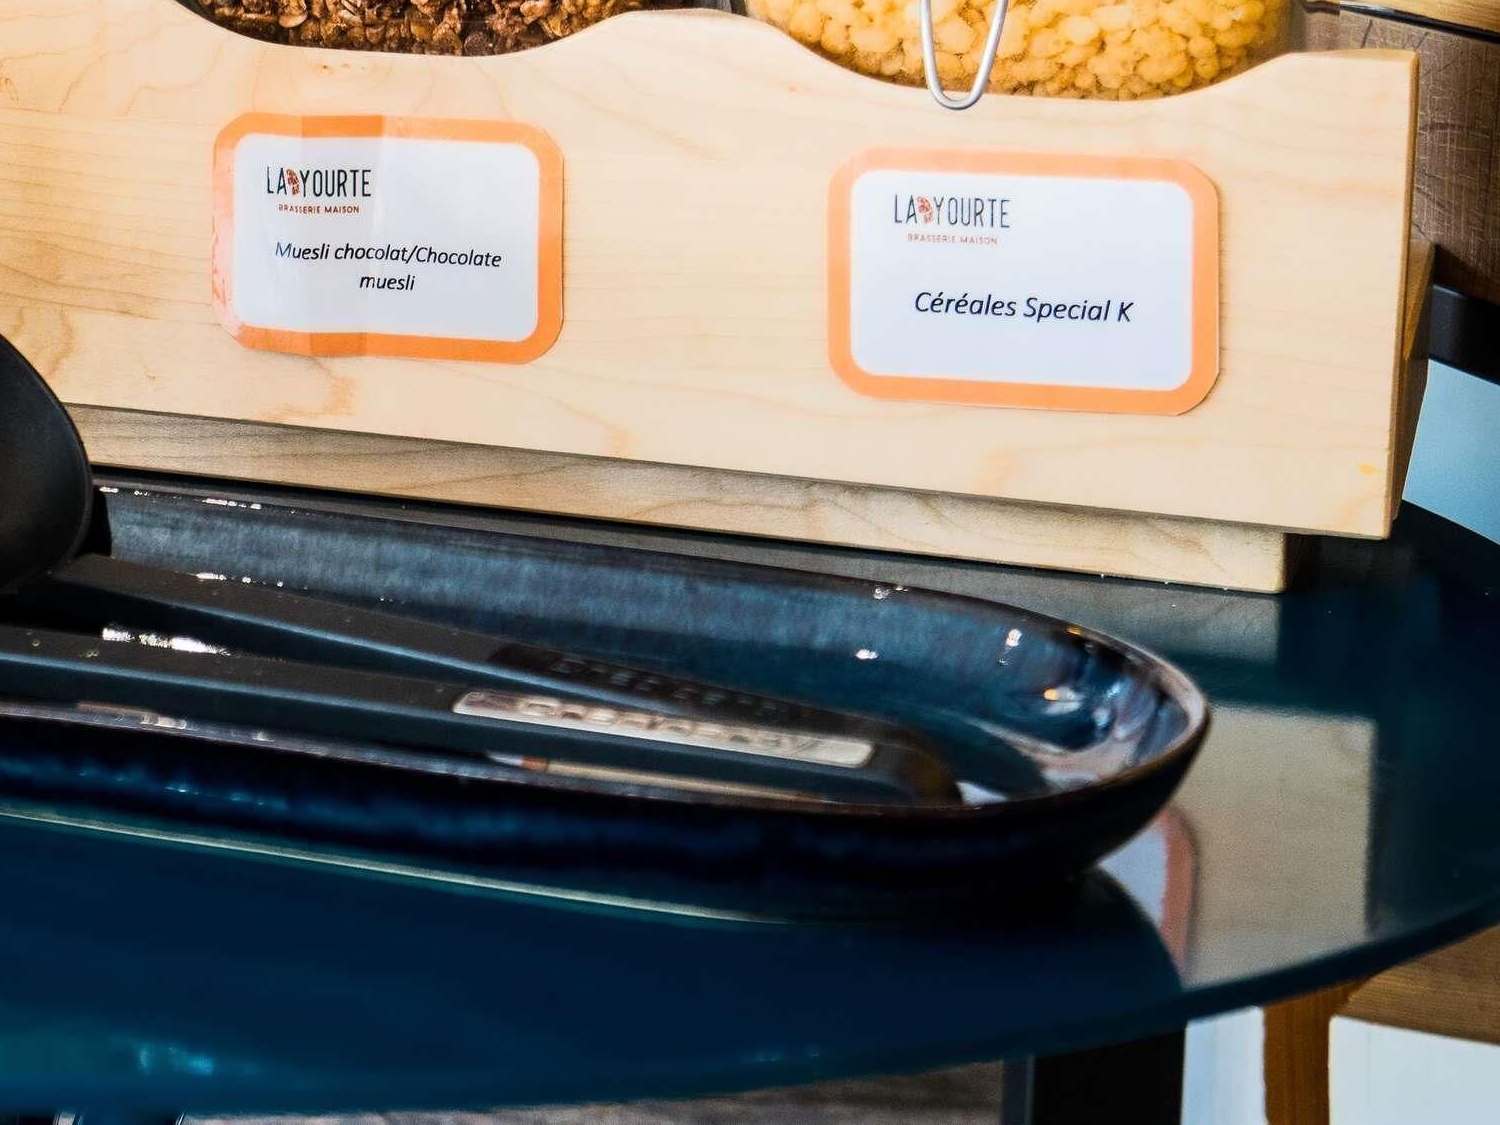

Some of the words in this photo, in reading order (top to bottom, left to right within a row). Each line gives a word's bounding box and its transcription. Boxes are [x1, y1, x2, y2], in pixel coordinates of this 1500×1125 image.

[266, 165, 287, 195] LA
[299, 169, 372, 198] YOURTE
[278, 203, 321, 215] BRASSERIE
[324, 205, 360, 215] MAISON
[894, 194, 918, 225] LA
[933, 196, 1011, 229] YOURTE
[907, 233, 957, 244] BRASSERIE
[960, 235, 998, 246] MAISON
[275, 241, 331, 261] Muesli
[334, 242, 502, 268] chocolat/Chocolate
[359, 274, 416, 292] muesli
[914, 291, 1018, 317] Céréales
[1023, 297, 1111, 323] Special
[1117, 302, 1135, 322] K
